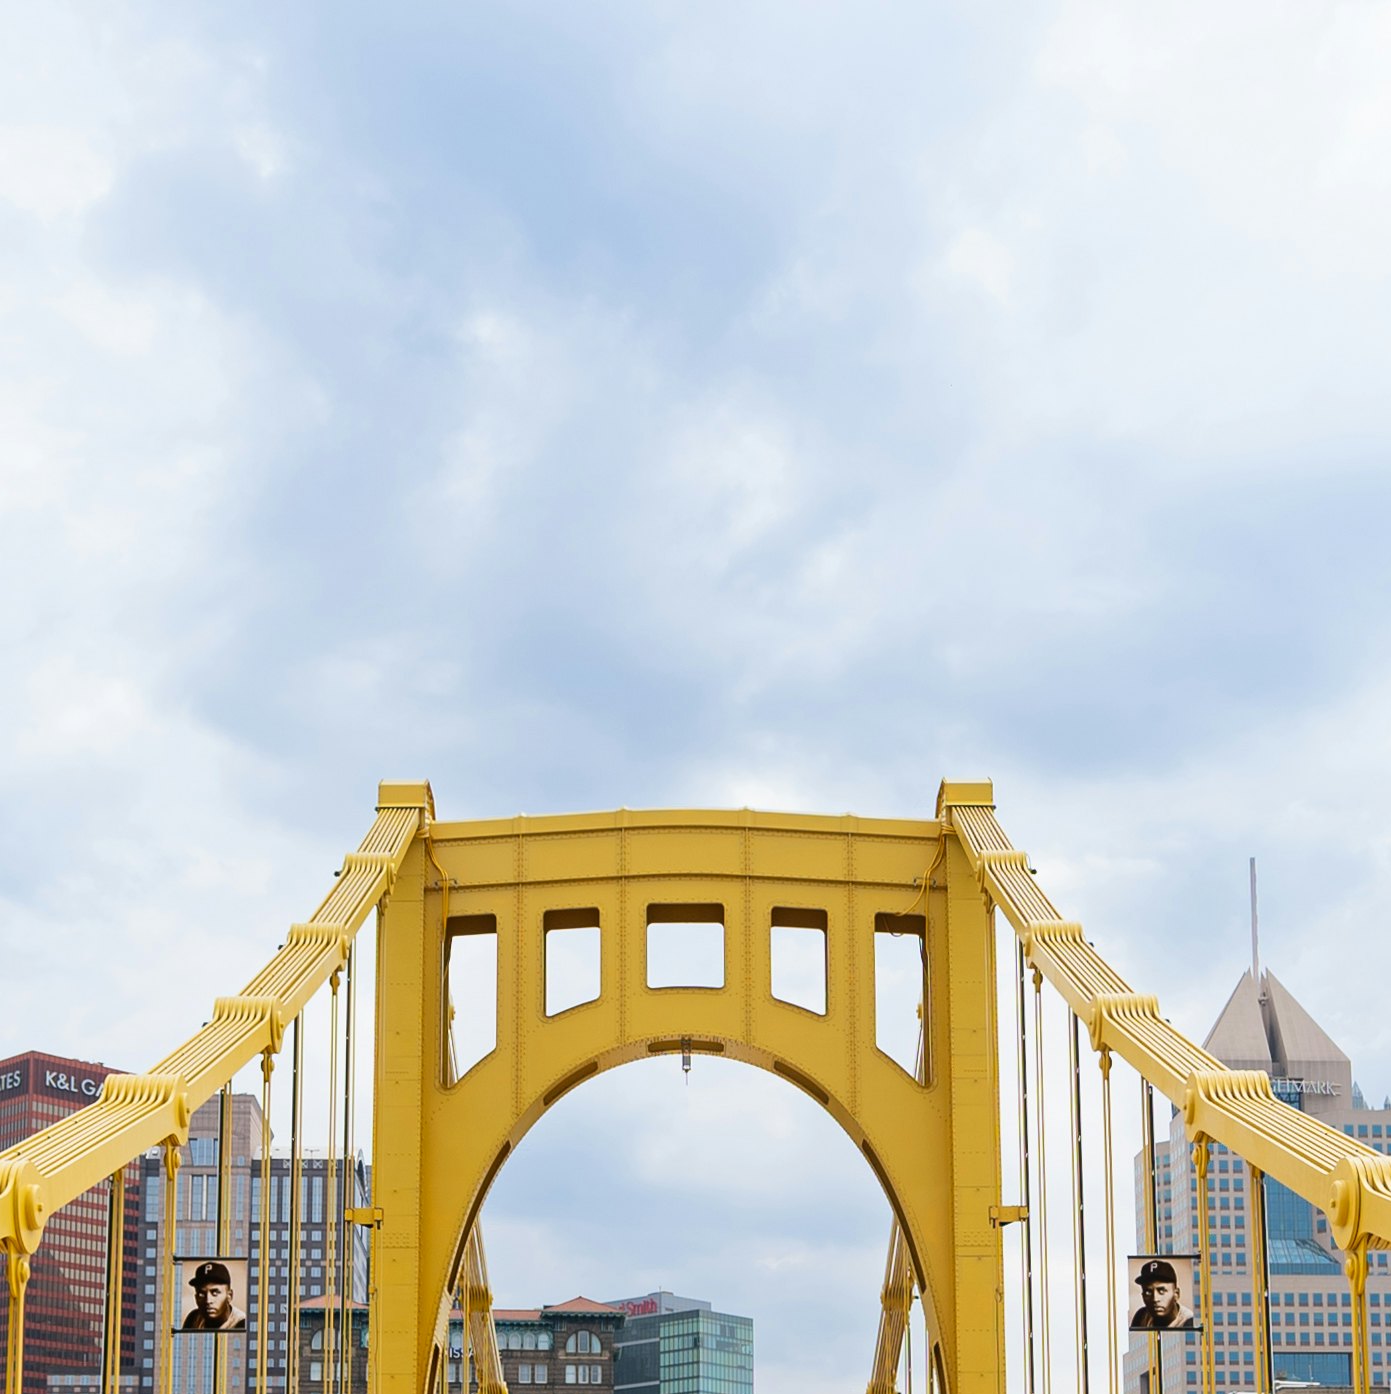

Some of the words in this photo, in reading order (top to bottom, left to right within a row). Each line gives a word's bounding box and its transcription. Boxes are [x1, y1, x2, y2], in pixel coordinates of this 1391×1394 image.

[45, 1069, 78, 1093] K&L
[1272, 1079, 1337, 1097] HMARK
[204, 1264, 213, 1275] P
[1150, 1262, 1158, 1273] P
